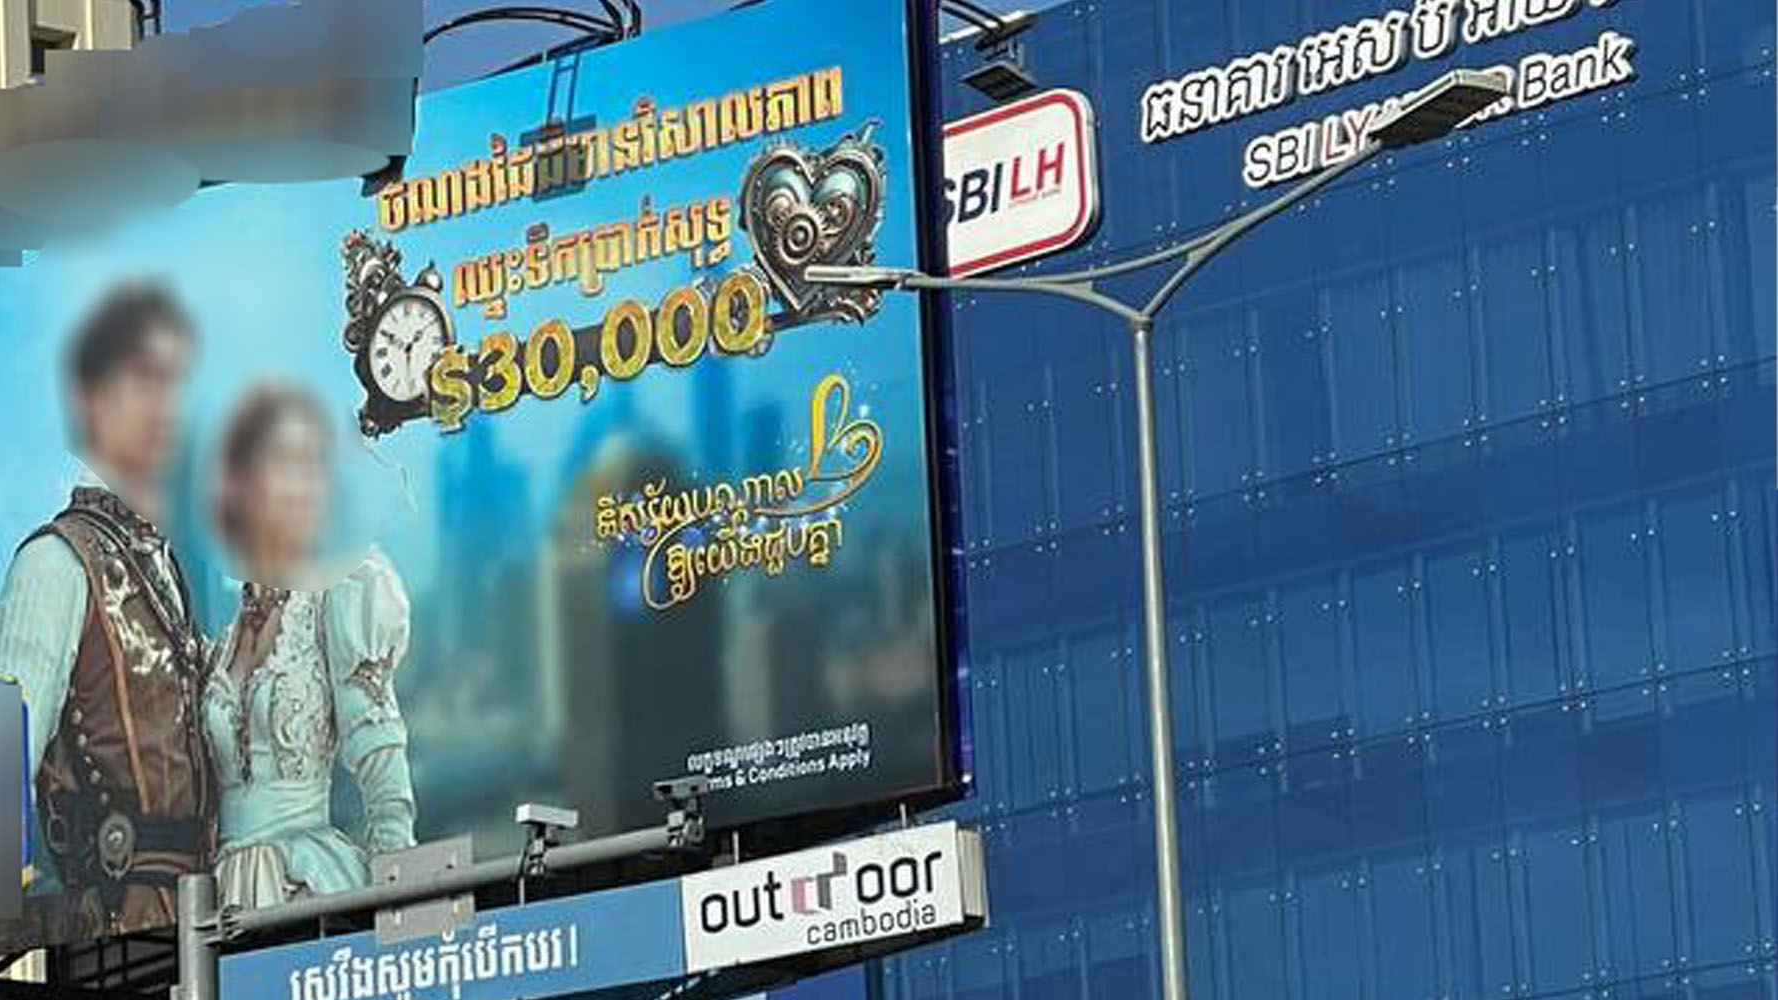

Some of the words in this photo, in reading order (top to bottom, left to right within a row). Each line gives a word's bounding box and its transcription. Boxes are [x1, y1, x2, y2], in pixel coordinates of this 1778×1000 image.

[1142, 46, 1298, 141] ធនាគារ
[1242, 131, 1314, 187] SBI
[1521, 33, 1634, 107] Bank
[430, 273, 771, 433] $30,000
[748, 758, 825, 784] Conditions
[827, 748, 870, 771] Apply
[807, 899, 937, 945] cambodia
